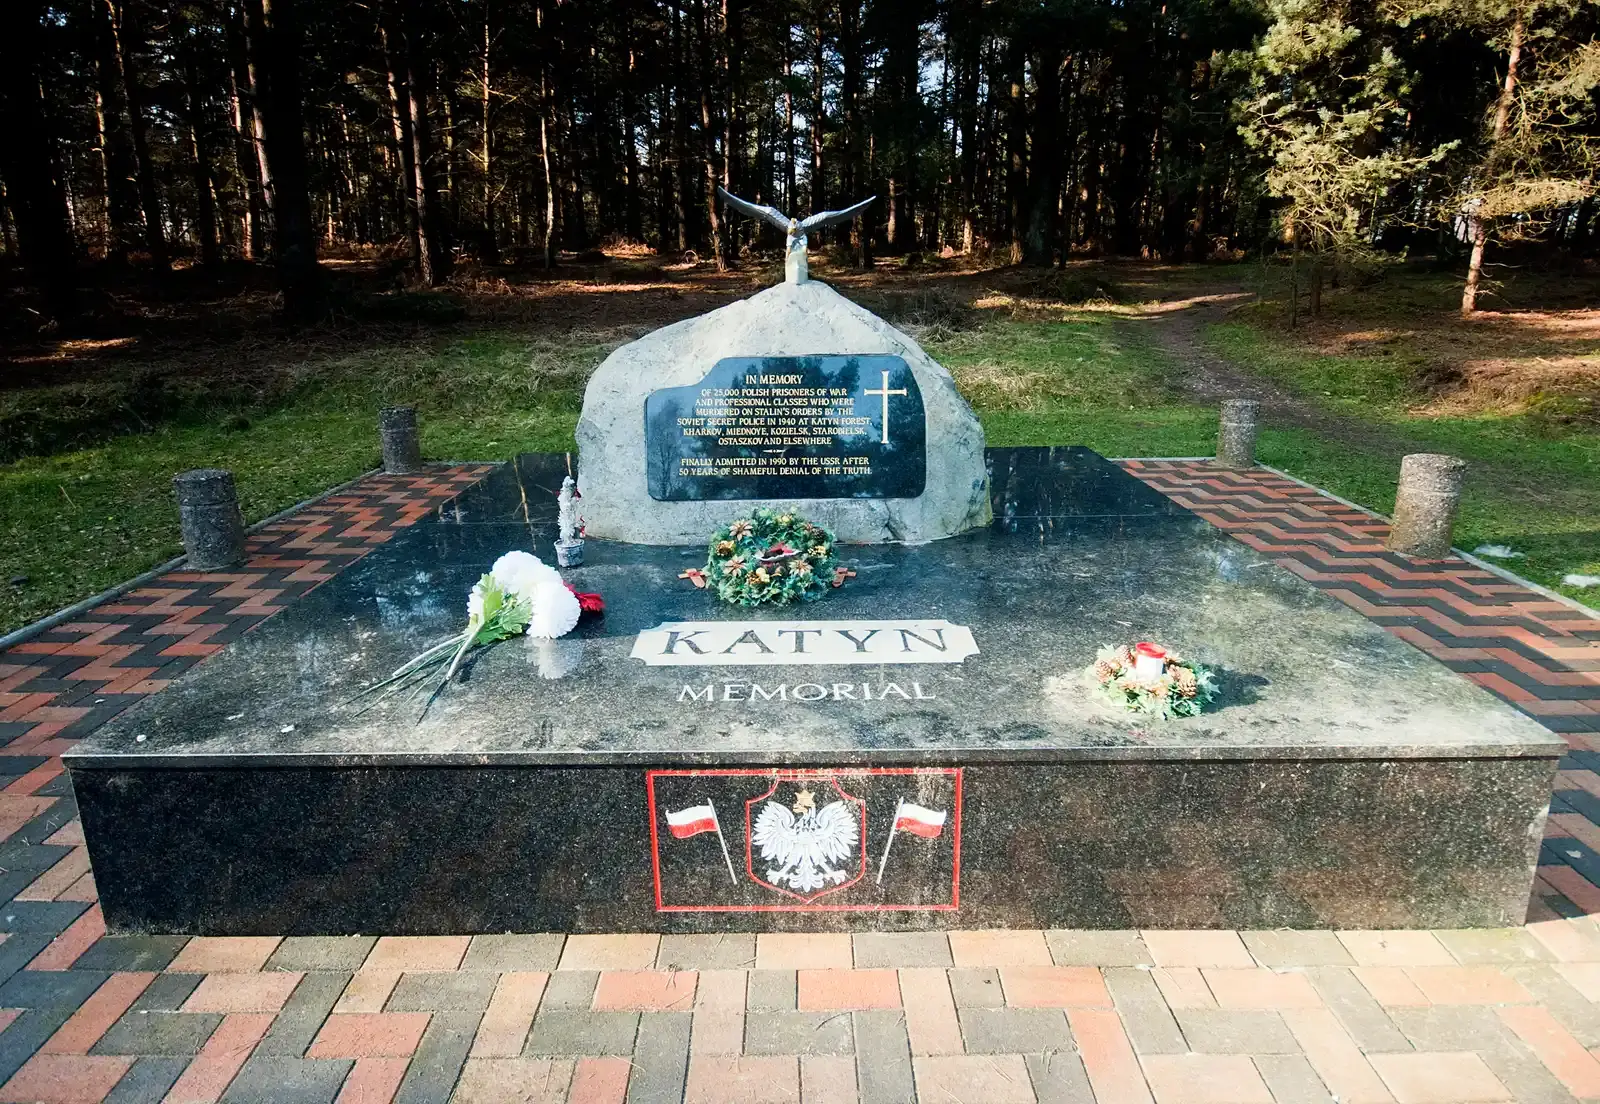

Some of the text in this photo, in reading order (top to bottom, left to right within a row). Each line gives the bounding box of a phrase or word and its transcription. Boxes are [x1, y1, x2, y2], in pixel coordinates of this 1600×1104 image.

[746, 375, 803, 384] IN MEMORY
[695, 398, 713, 406] AND
[715, 398, 771, 406] PROFESSIONAL
[773, 398, 808, 406] CLASSES
[810, 398, 829, 406] WHO
[696, 408, 740, 416] MURDERED
[677, 418, 705, 426] SOVIET
[764, 437, 782, 445] AND
[784, 437, 831, 445] ELSEWHERE
[681, 458, 714, 466] FINALLY
[820, 457, 840, 465] USSR
[843, 457, 869, 465] AFTER
[679, 468, 689, 476] 50
[691, 468, 718, 476] YEARS
[780, 467, 810, 475] DENIAL
[812, 467, 822, 475] OF
[658, 628, 950, 655] KATYN
[677, 682, 936, 702] MEMORIAL
